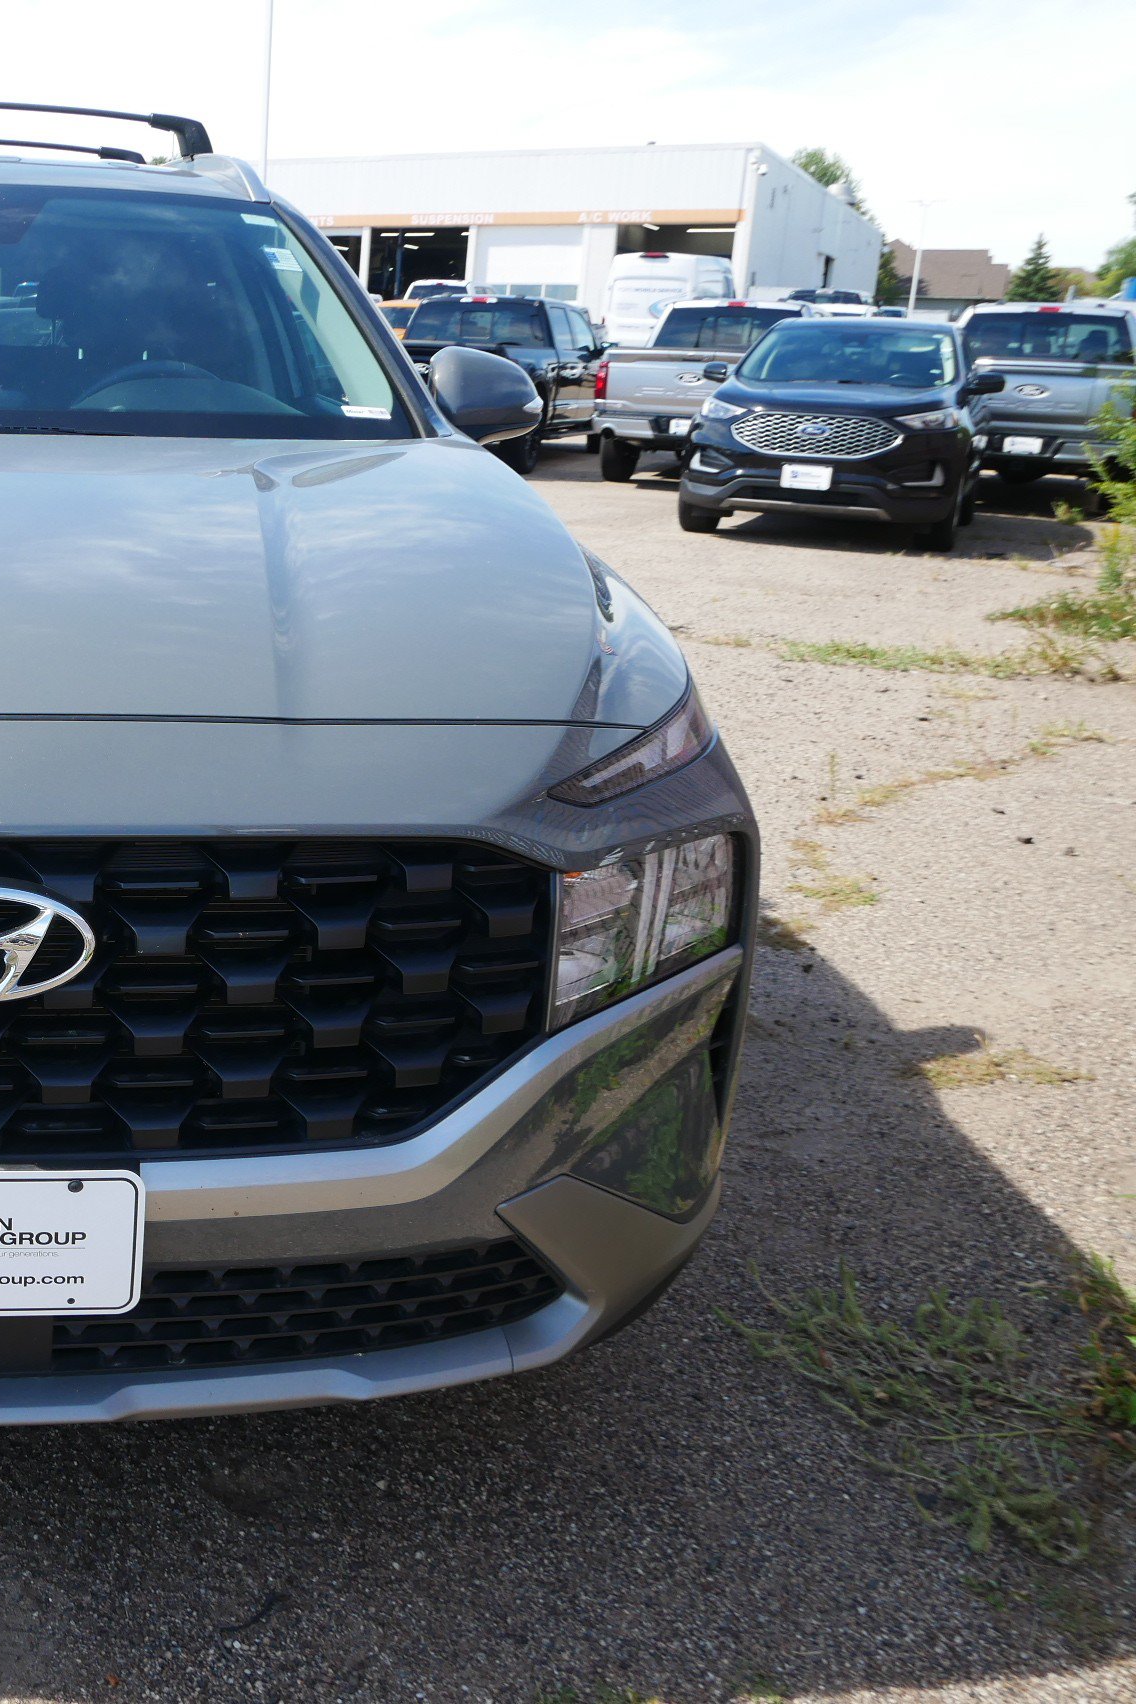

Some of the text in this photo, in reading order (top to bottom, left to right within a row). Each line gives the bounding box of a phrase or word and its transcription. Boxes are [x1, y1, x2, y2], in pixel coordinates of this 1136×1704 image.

[411, 214, 494, 225] SUSPENSION
[577, 210, 653, 223] A/C WORK
[0, 1231, 87, 1246] GROUP
